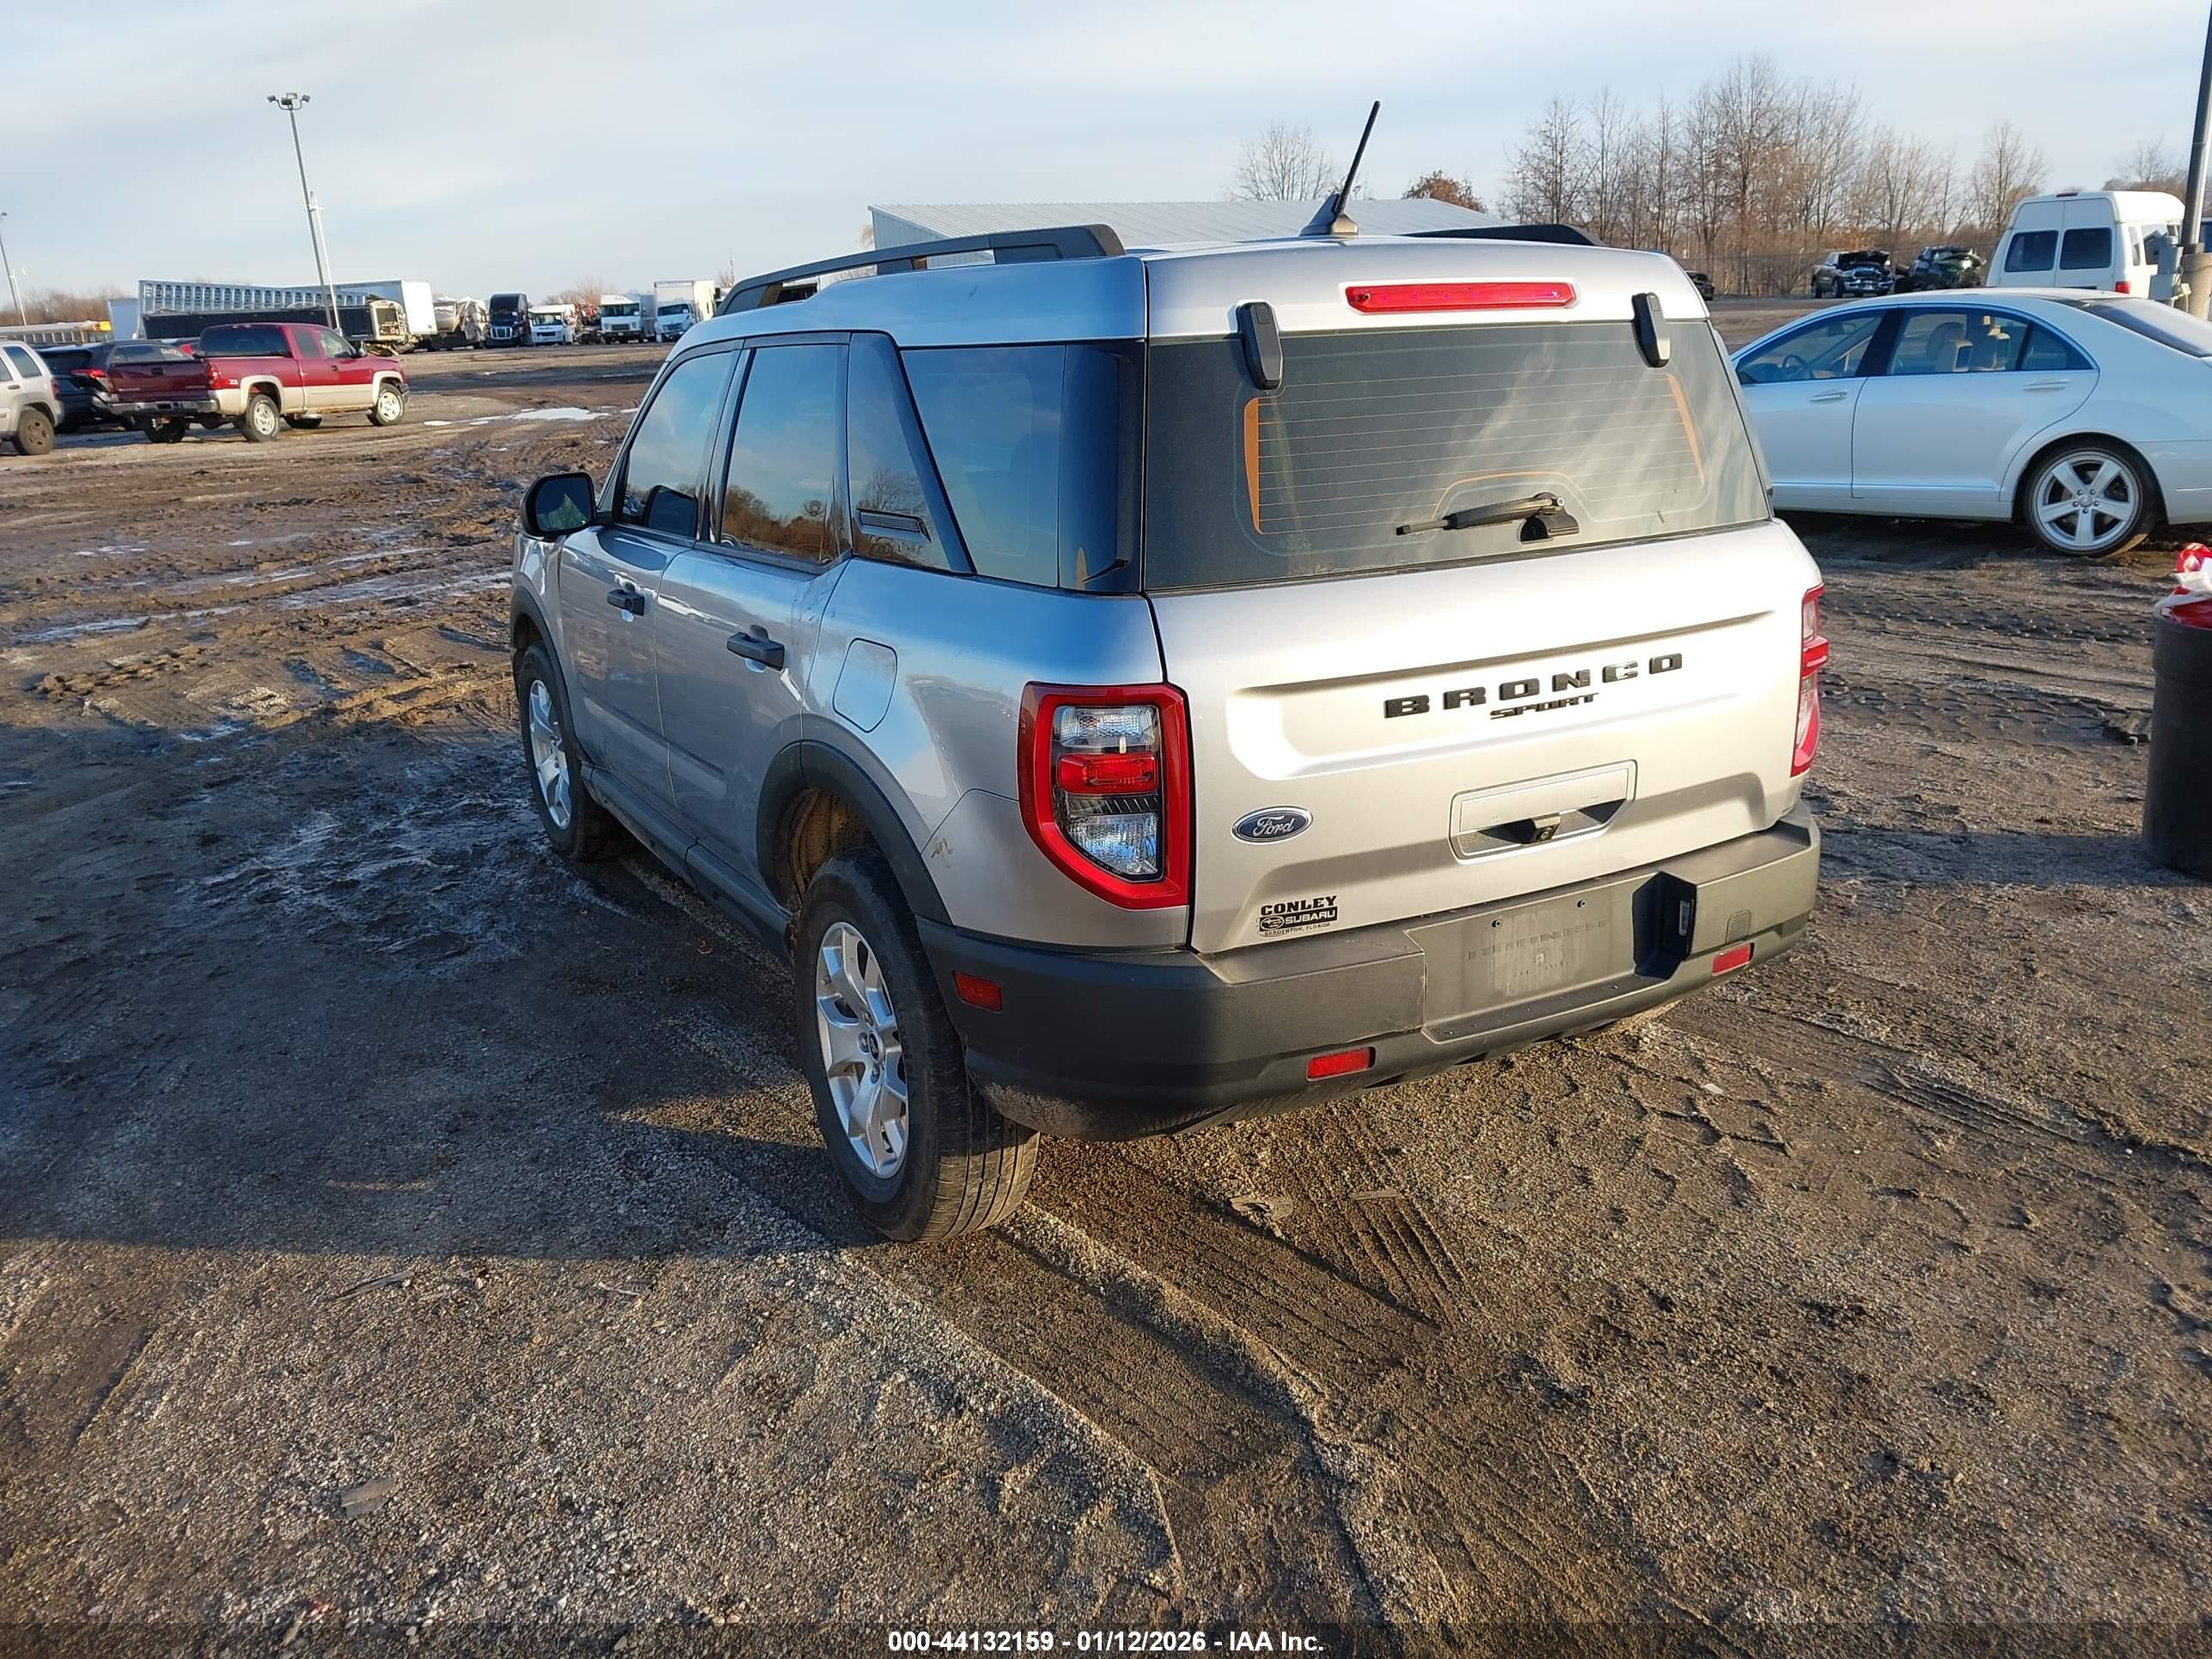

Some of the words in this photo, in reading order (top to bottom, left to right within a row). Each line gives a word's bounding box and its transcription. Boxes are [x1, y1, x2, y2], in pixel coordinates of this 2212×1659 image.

[1383, 653, 1683, 719] BRONCO
[1490, 692, 1600, 720] SPORT
[1252, 815, 1295, 837] Ford
[1261, 895, 1338, 916] CONLEY
[1285, 910, 1336, 925] SUBARU
